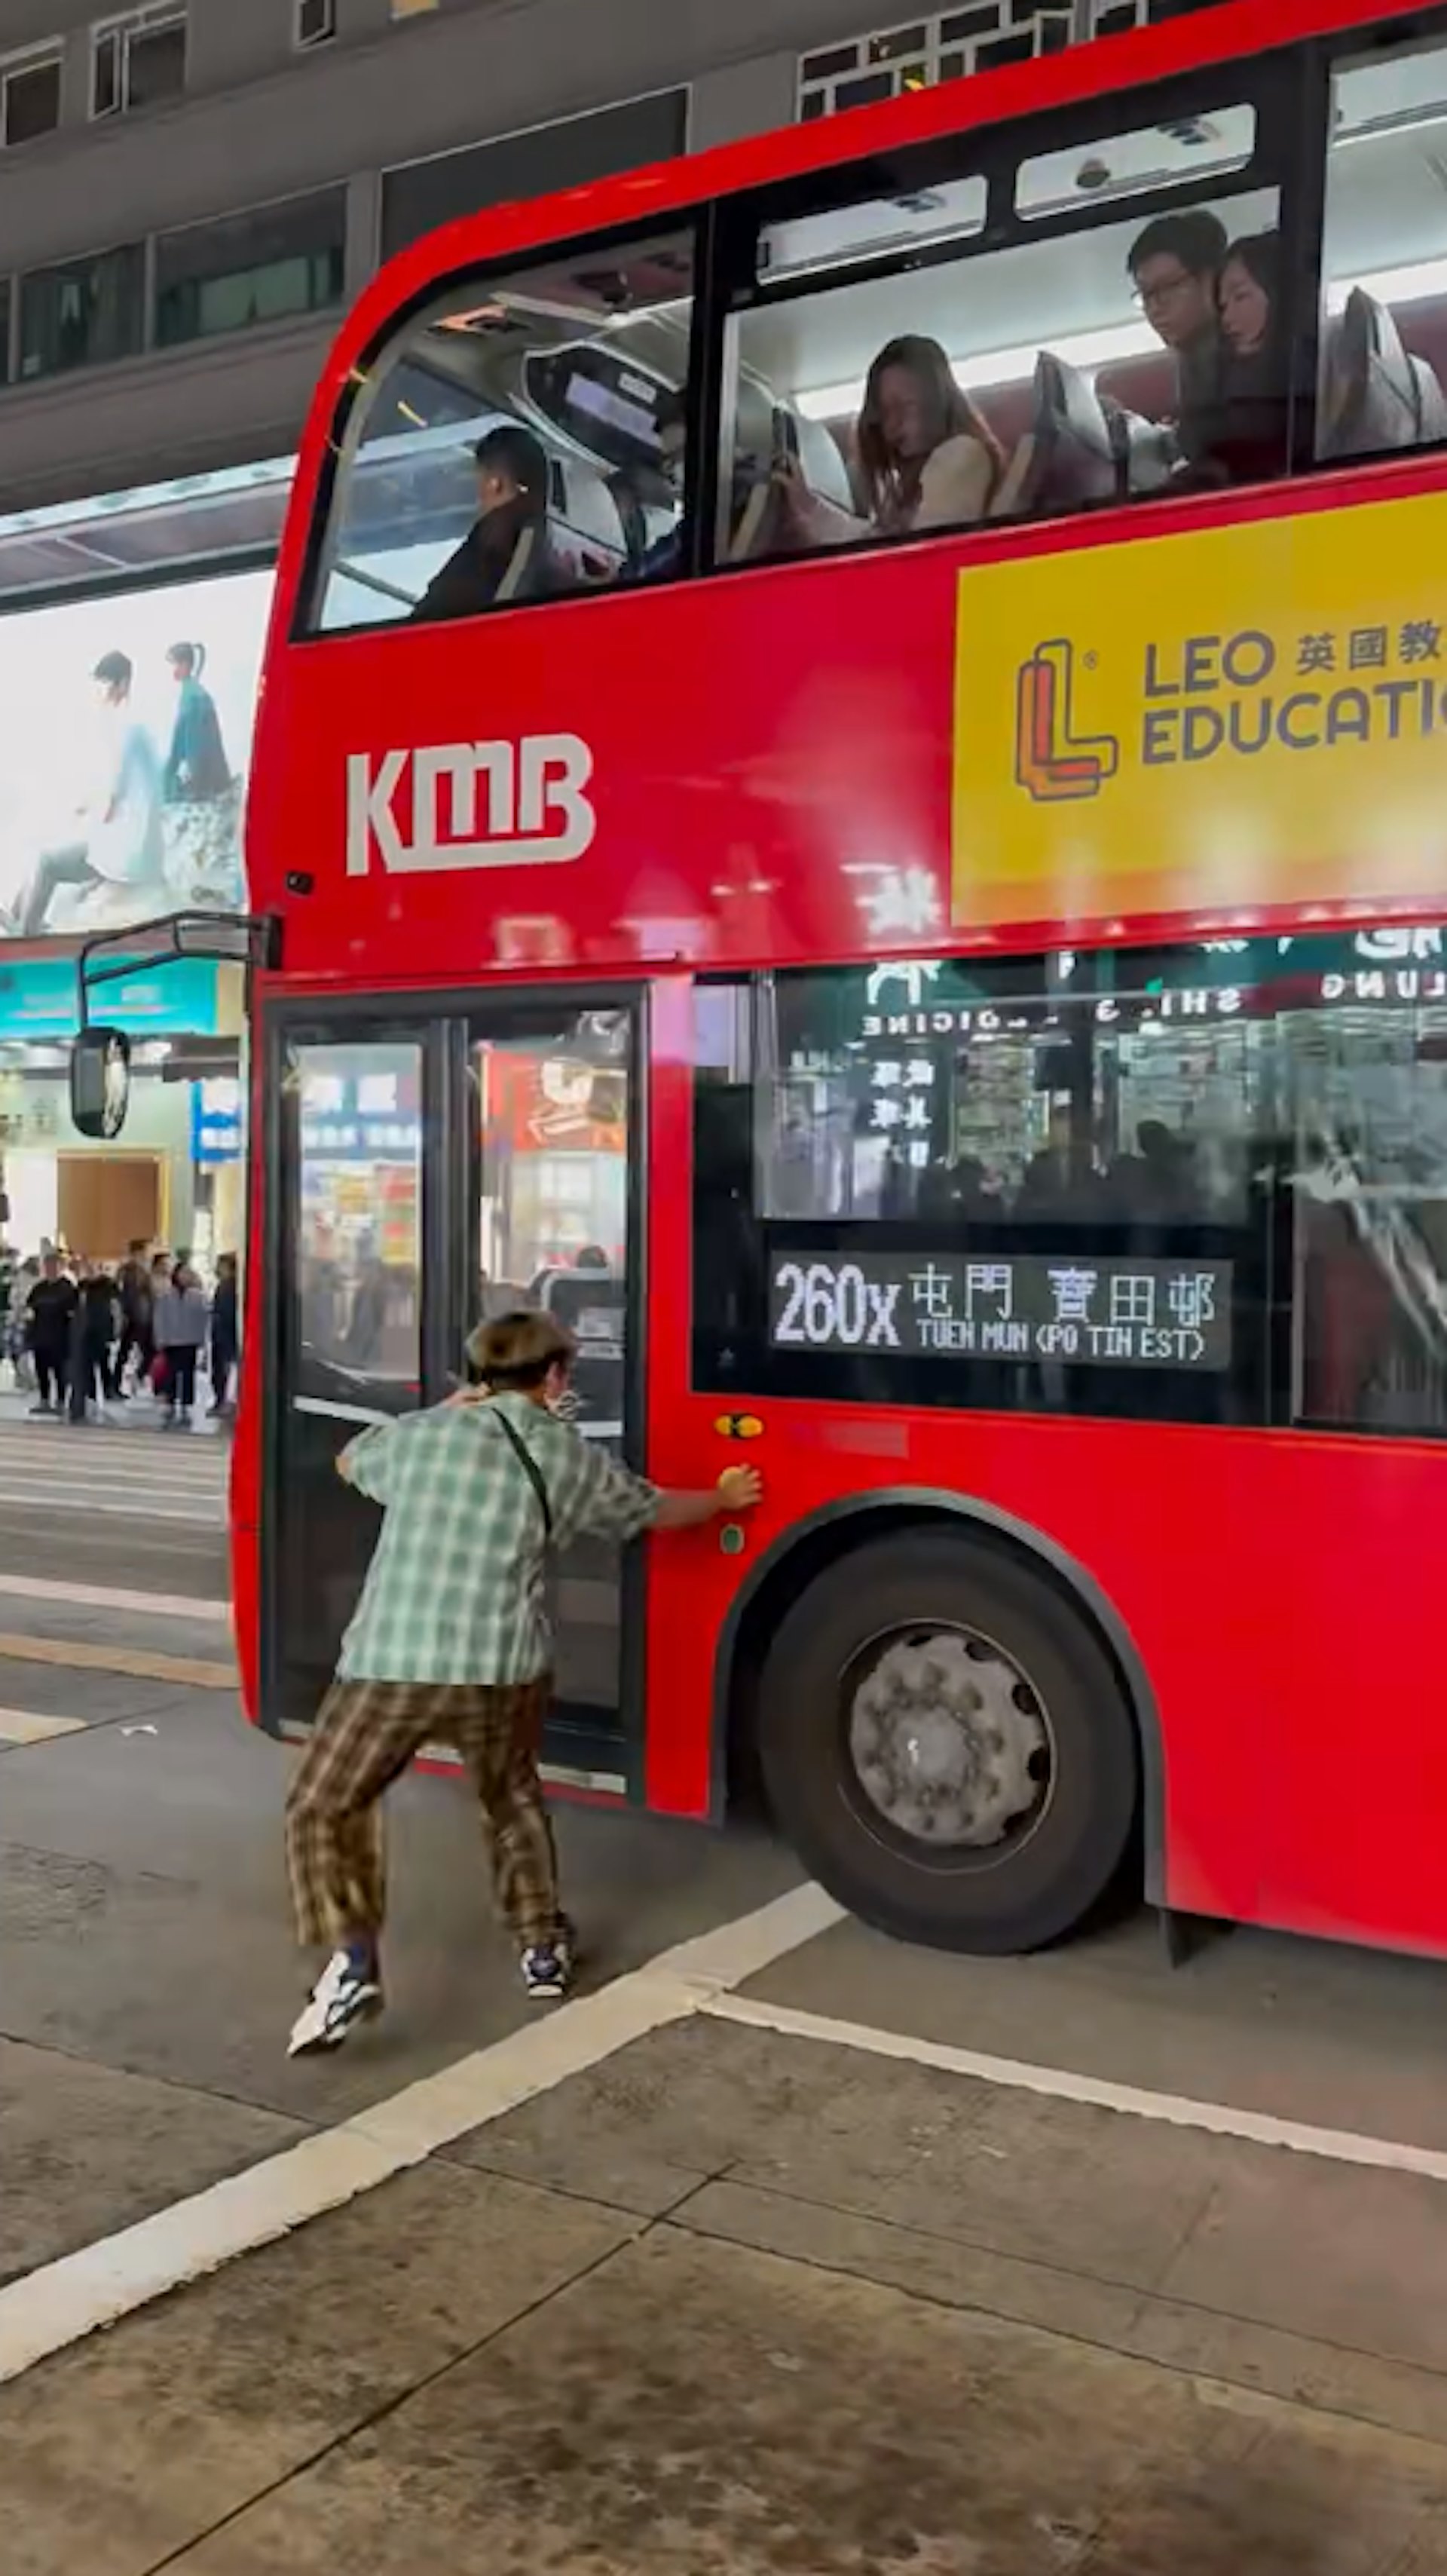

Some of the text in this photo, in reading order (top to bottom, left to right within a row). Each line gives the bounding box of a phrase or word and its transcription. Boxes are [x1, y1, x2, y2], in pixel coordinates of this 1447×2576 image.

[1145, 630, 1276, 698] LEO
[1296, 620, 1441, 676] 英國教
[1142, 678, 1447, 765] EDUCATI
[346, 733, 595, 876] KMB
[908, 1263, 1215, 1328] 屯門 寶田邨
[916, 1319, 1204, 1361] TUEN MUN (PO TIN EST)
